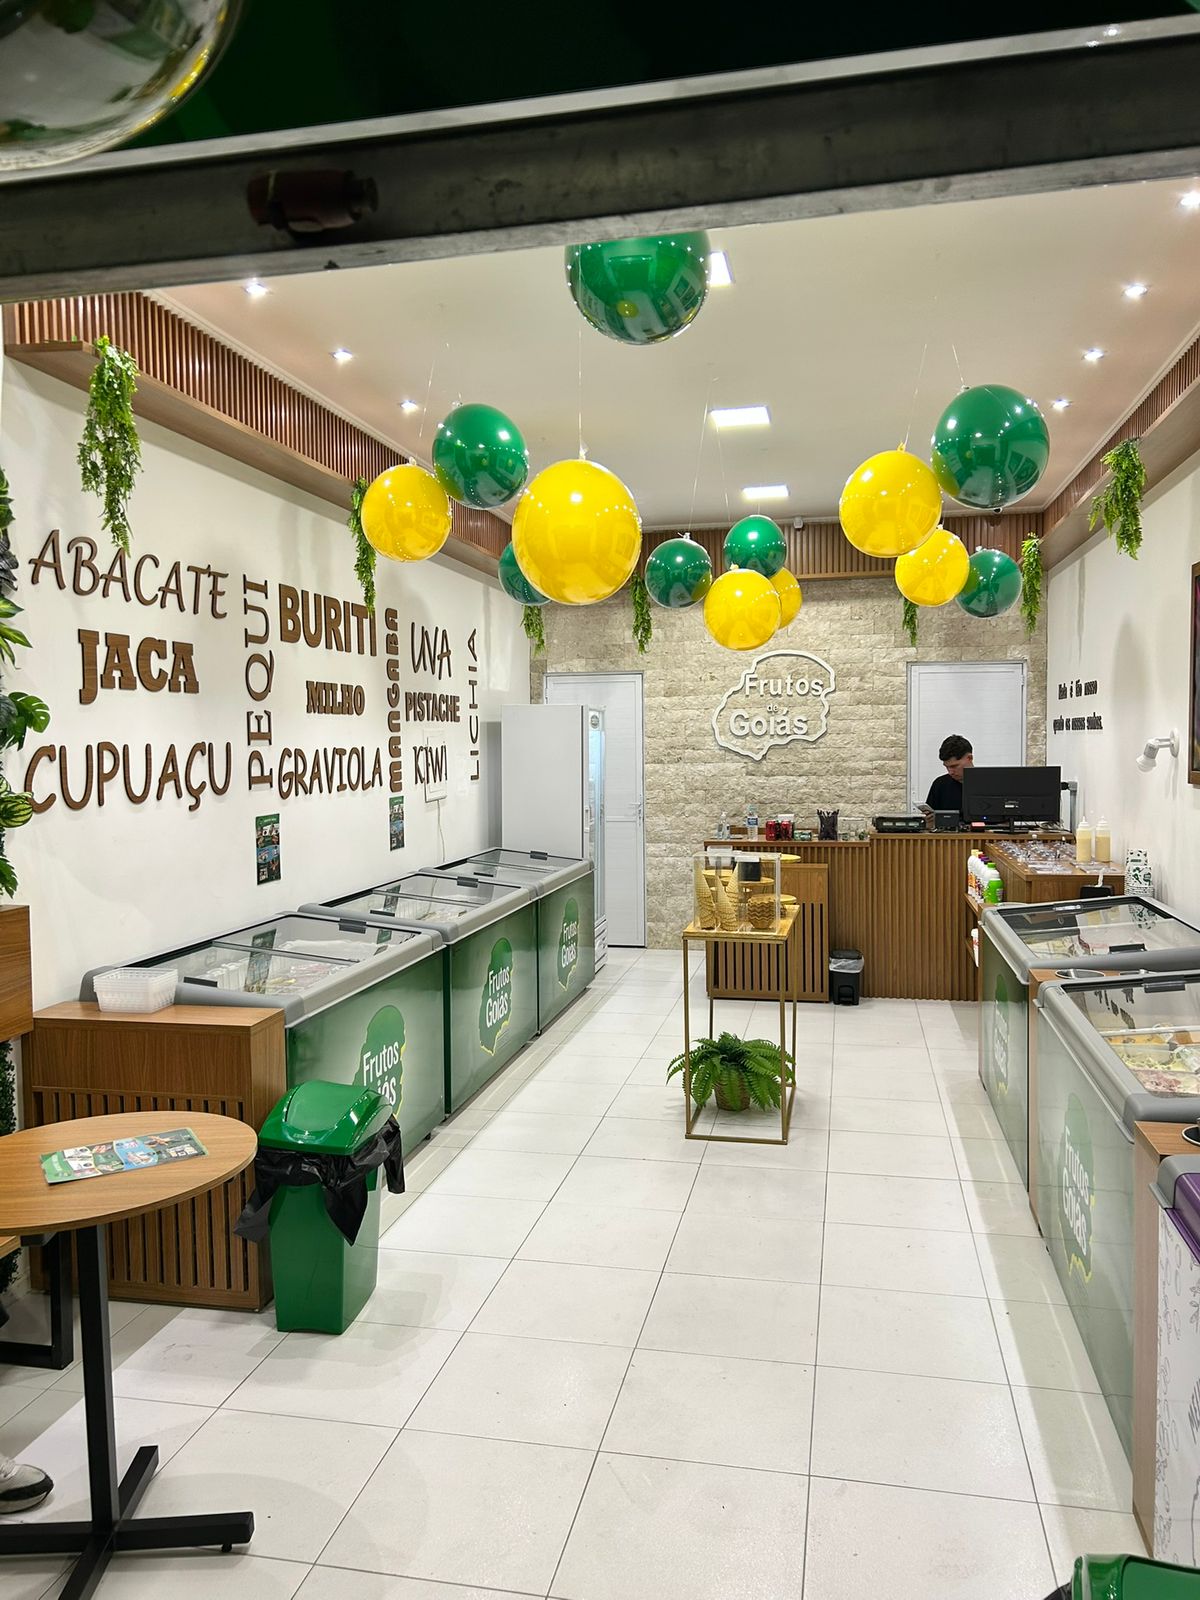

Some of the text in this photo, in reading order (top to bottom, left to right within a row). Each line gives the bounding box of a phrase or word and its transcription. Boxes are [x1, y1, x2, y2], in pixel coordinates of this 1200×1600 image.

[28, 528, 230, 620] ABACATE
[278, 583, 377, 657] BURITI
[77, 628, 200, 705] JACA
[411, 621, 452, 681] UVA
[243, 574, 275, 791] PEQUI
[305, 681, 366, 717] MILHO
[384, 607, 402, 793] MANGABA
[405, 691, 461, 723] PISTACHE
[467, 628, 480, 781] LICHIA
[745, 674, 824, 696] Frutos
[729, 708, 809, 736] Goiás
[767, 704, 779, 712] de
[24, 741, 232, 812] CUPUAÇU
[278, 746, 384, 800] GRAVIOLA
[413, 745, 447, 785] KIWI
[562, 941, 576, 968] Goiás
[563, 921, 577, 943] Frutos
[488, 966, 510, 997] Frutos
[486, 991, 508, 1028] Goiás
[363, 1041, 399, 1087] Frutos
[1065, 1125, 1089, 1205] Frutos
[1063, 1166, 1087, 1256] Goiás
